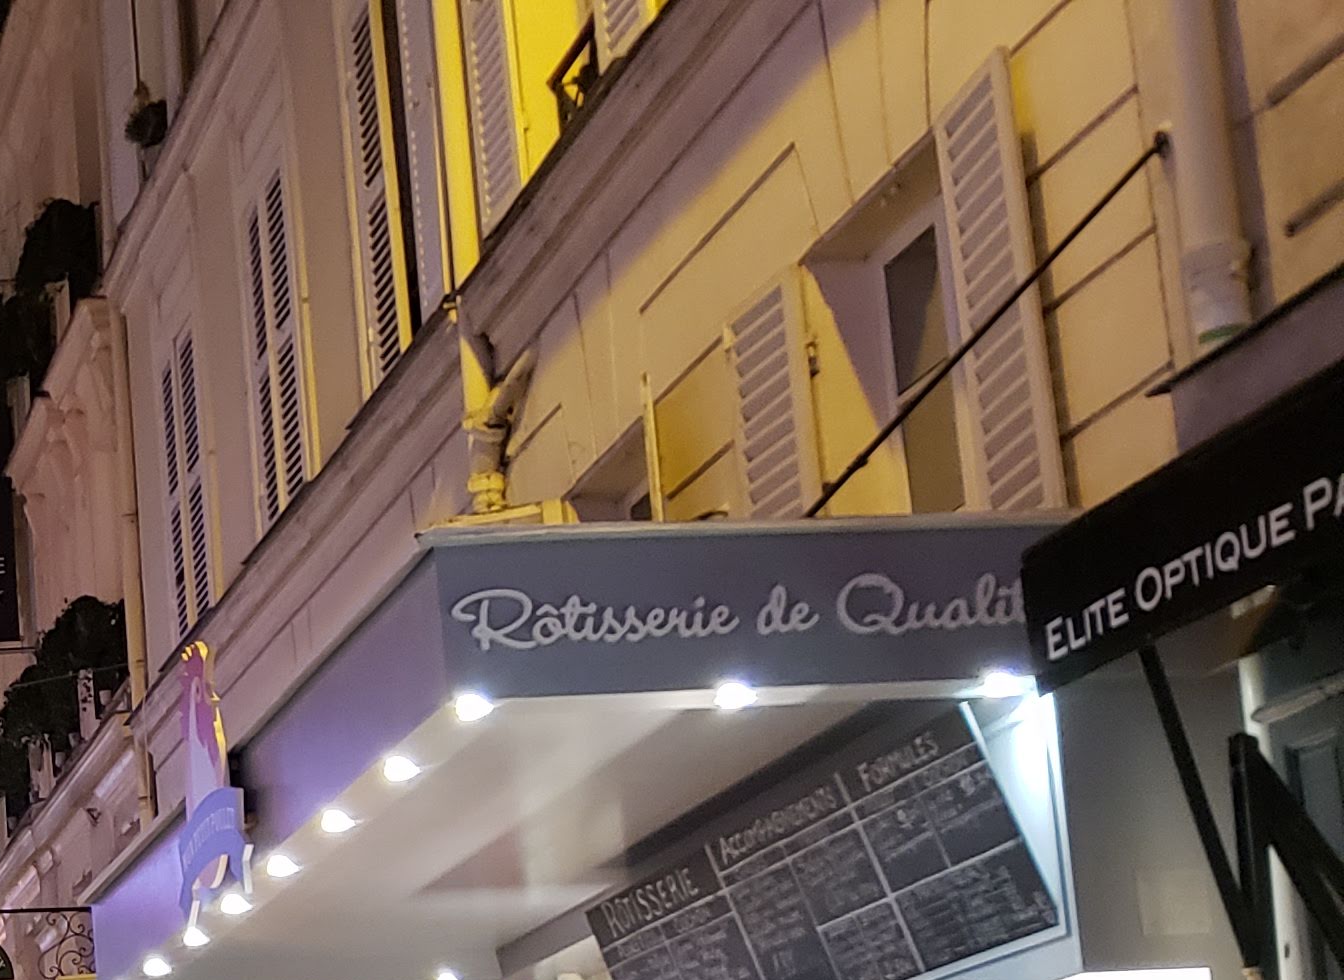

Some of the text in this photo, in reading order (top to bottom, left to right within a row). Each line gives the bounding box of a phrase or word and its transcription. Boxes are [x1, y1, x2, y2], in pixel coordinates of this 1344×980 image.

[451, 588, 740, 652] Rôtisserie
[755, 584, 819, 637] de
[1045, 588, 1130, 662] ELITE
[1134, 502, 1297, 613] OPTIQUE
